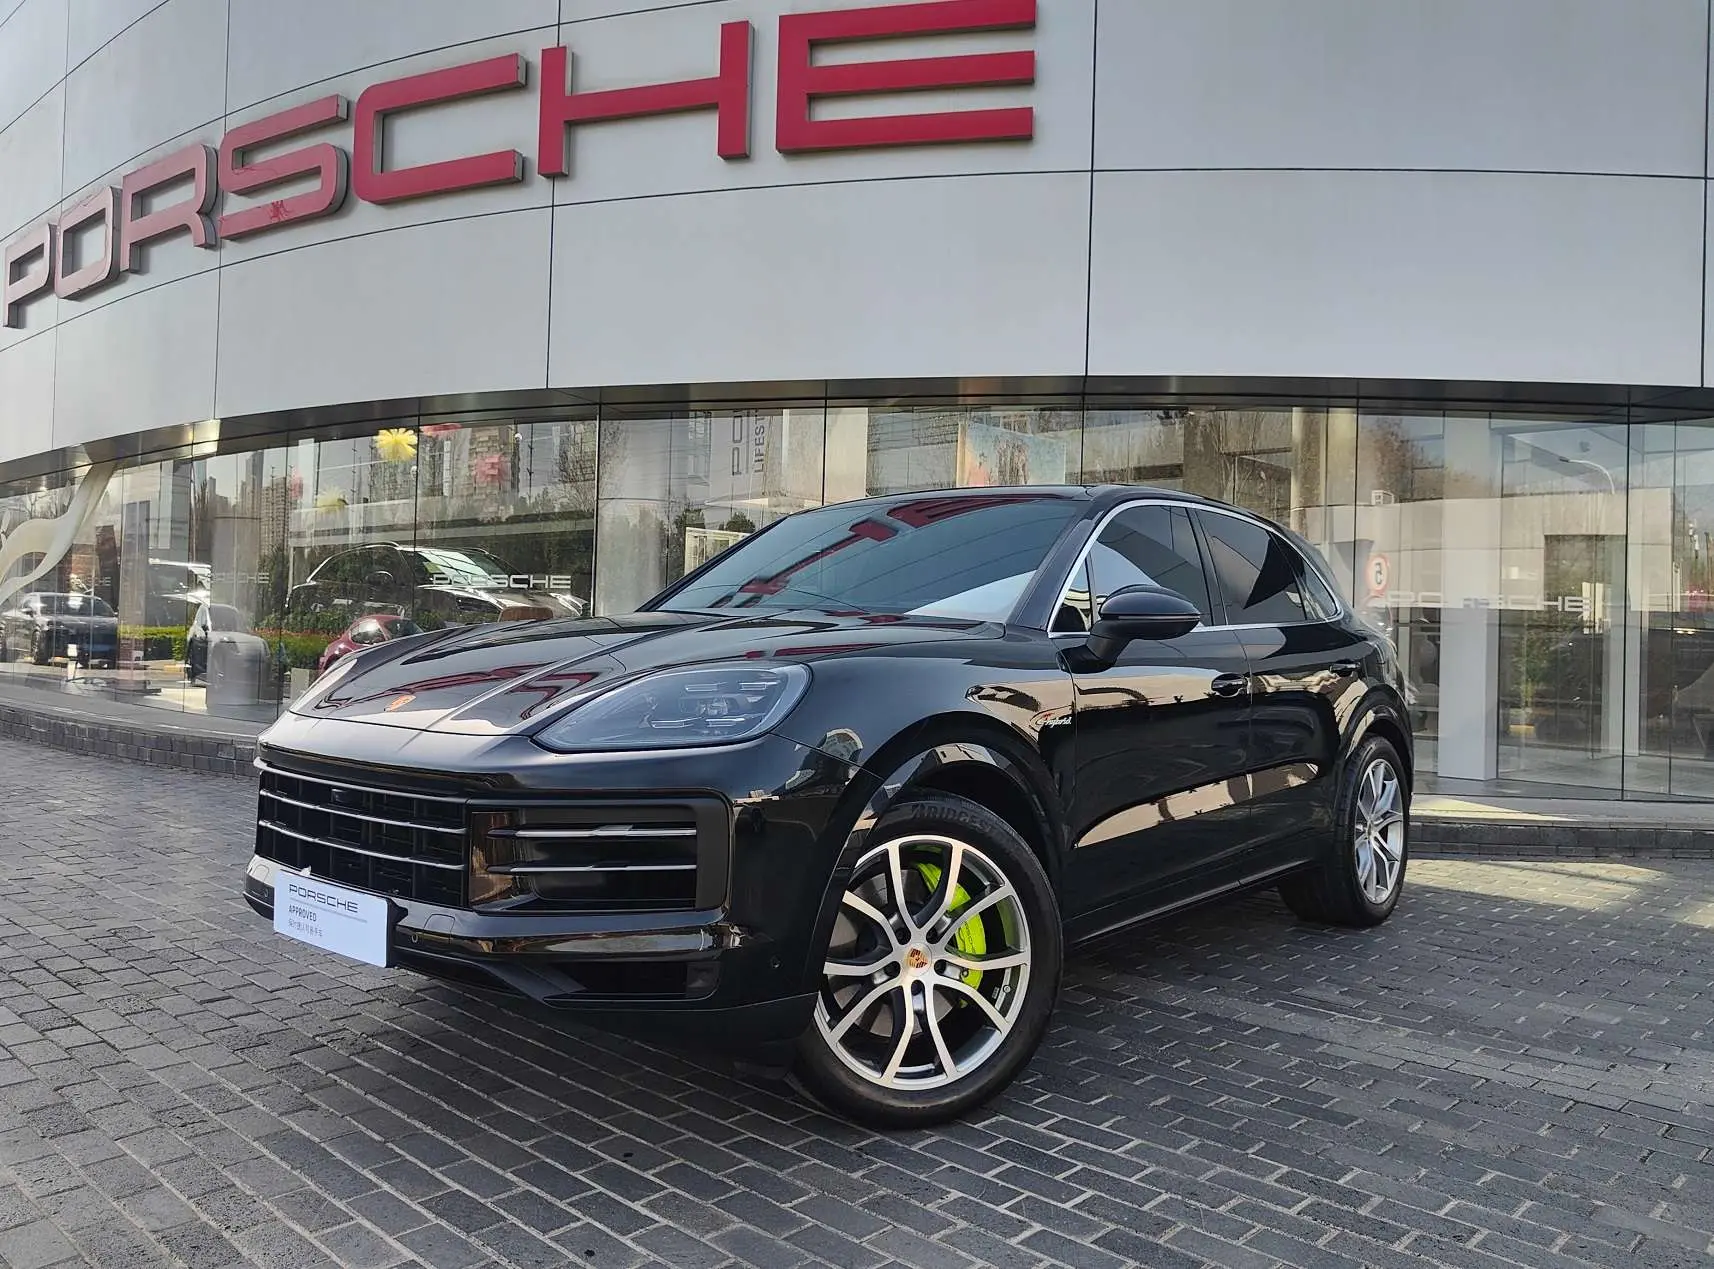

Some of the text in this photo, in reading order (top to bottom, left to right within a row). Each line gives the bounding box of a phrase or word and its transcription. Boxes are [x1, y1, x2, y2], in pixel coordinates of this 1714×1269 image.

[3, 0, 1036, 328] PORSCHE
[432, 574, 572, 589] PORSCHE
[289, 884, 358, 913] PORSCHE
[288, 904, 317, 922] APPROVED
